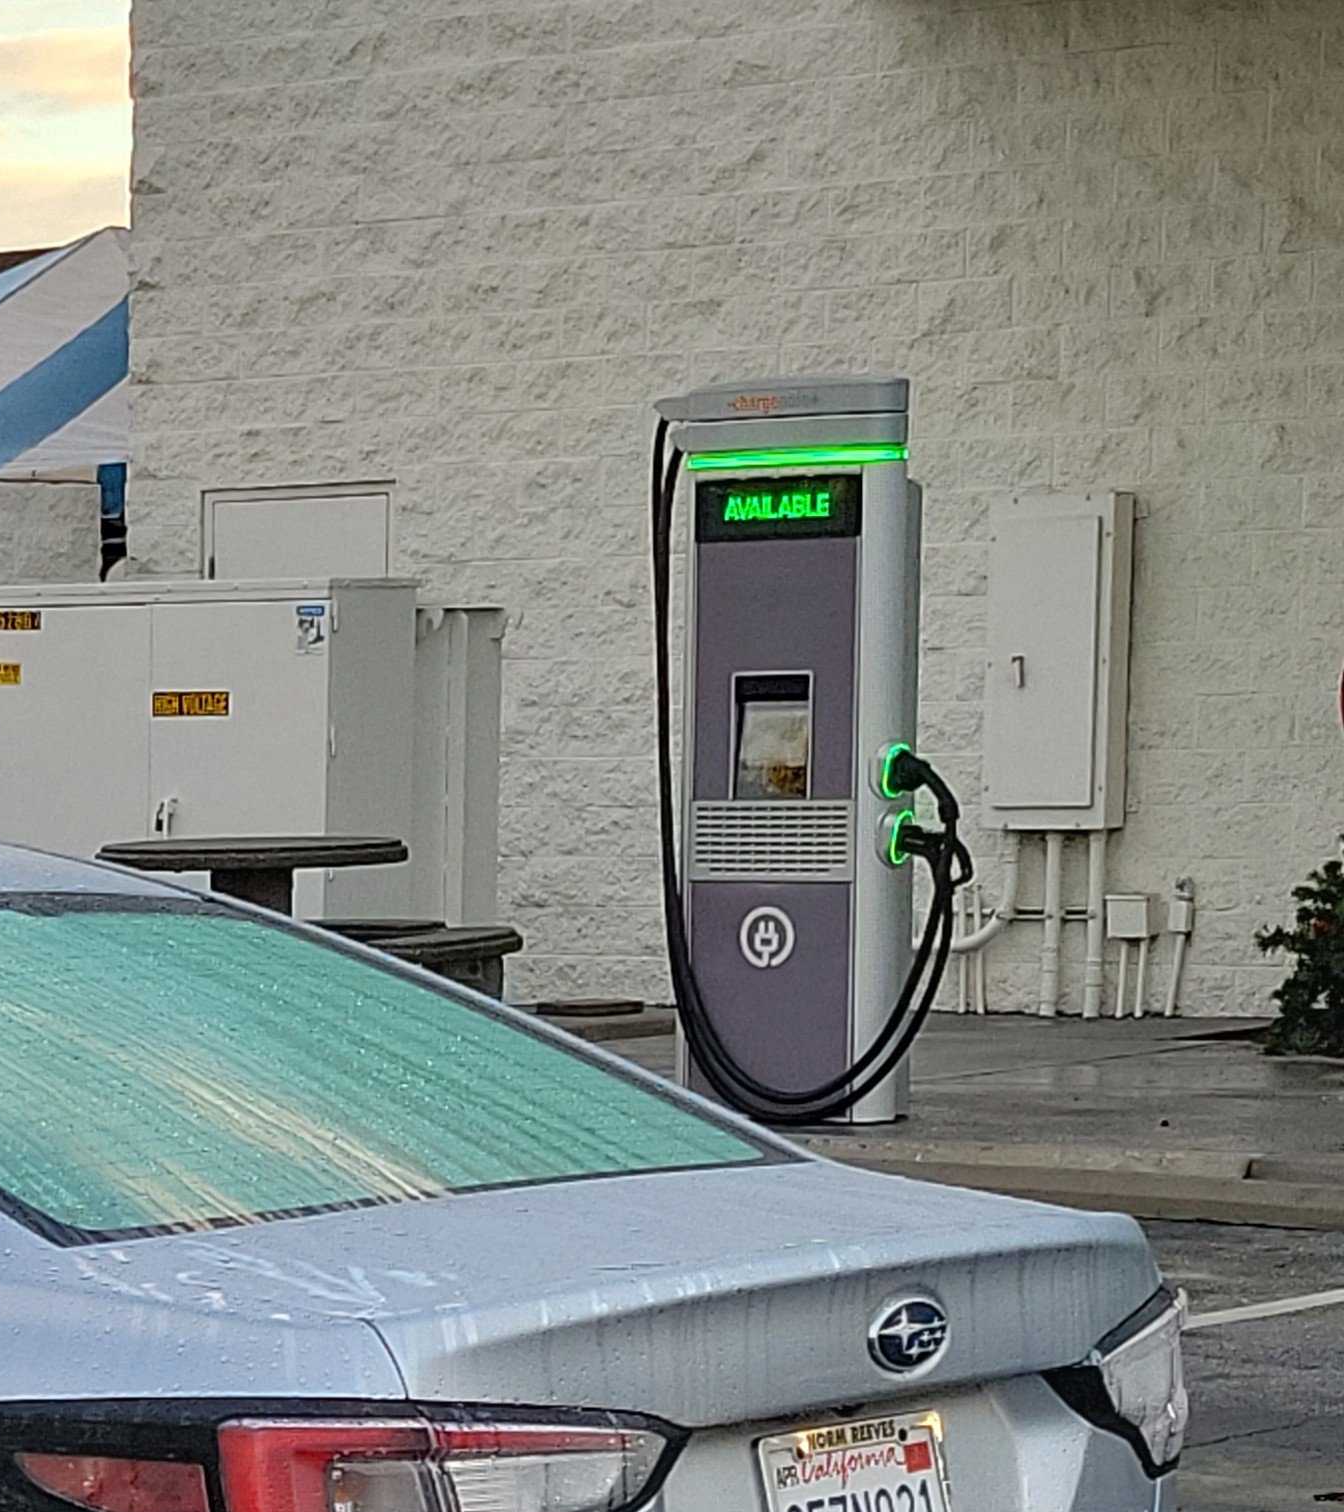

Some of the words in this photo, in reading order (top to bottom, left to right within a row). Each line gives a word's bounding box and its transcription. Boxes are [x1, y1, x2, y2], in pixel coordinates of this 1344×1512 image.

[724, 492, 830, 521] AVAILABLE
[154, 694, 179, 714] HIGH
[182, 693, 228, 714] VOLTAGE
[807, 1428, 847, 1451] NORM
[851, 1419, 896, 1443] REEVES
[777, 1464, 800, 1489] APR
[799, 1446, 906, 1488] California
